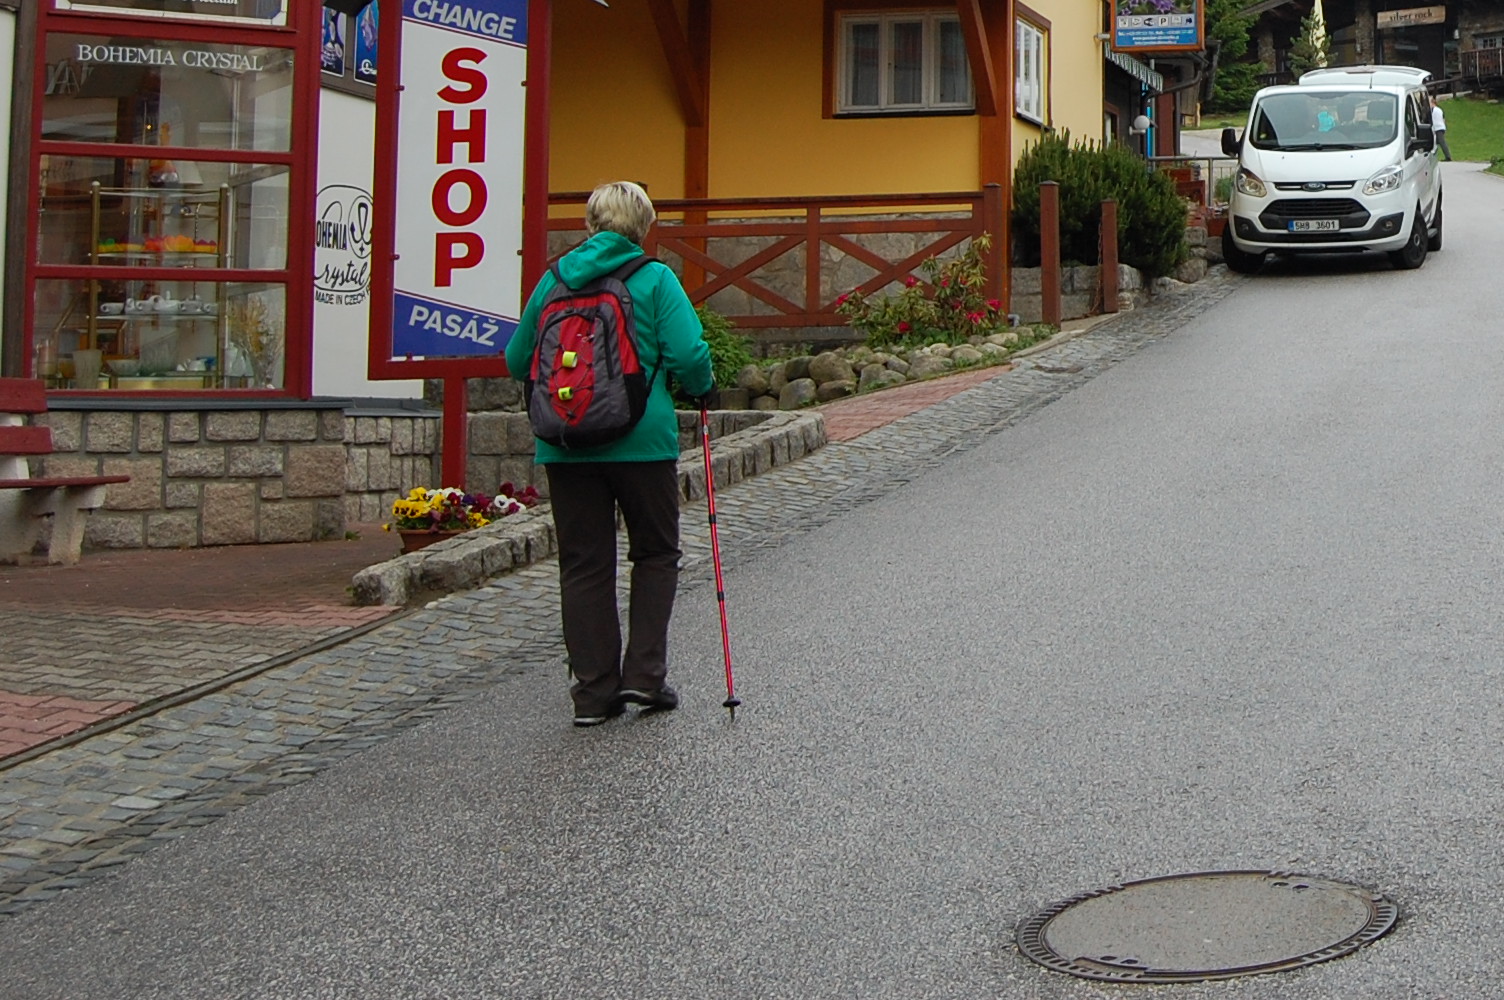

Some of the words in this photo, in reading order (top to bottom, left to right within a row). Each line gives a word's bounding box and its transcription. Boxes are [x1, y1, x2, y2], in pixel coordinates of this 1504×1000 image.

[77, 44, 176, 66] BOHEMIA
[182, 50, 264, 72] CRYSTAL
[432, 47, 489, 288] SHOP
[315, 219, 348, 251] OHEMIA
[315, 289, 335, 304] MADE
[335, 294, 343, 305] IN
[408, 304, 499, 347] PASÁŽ
